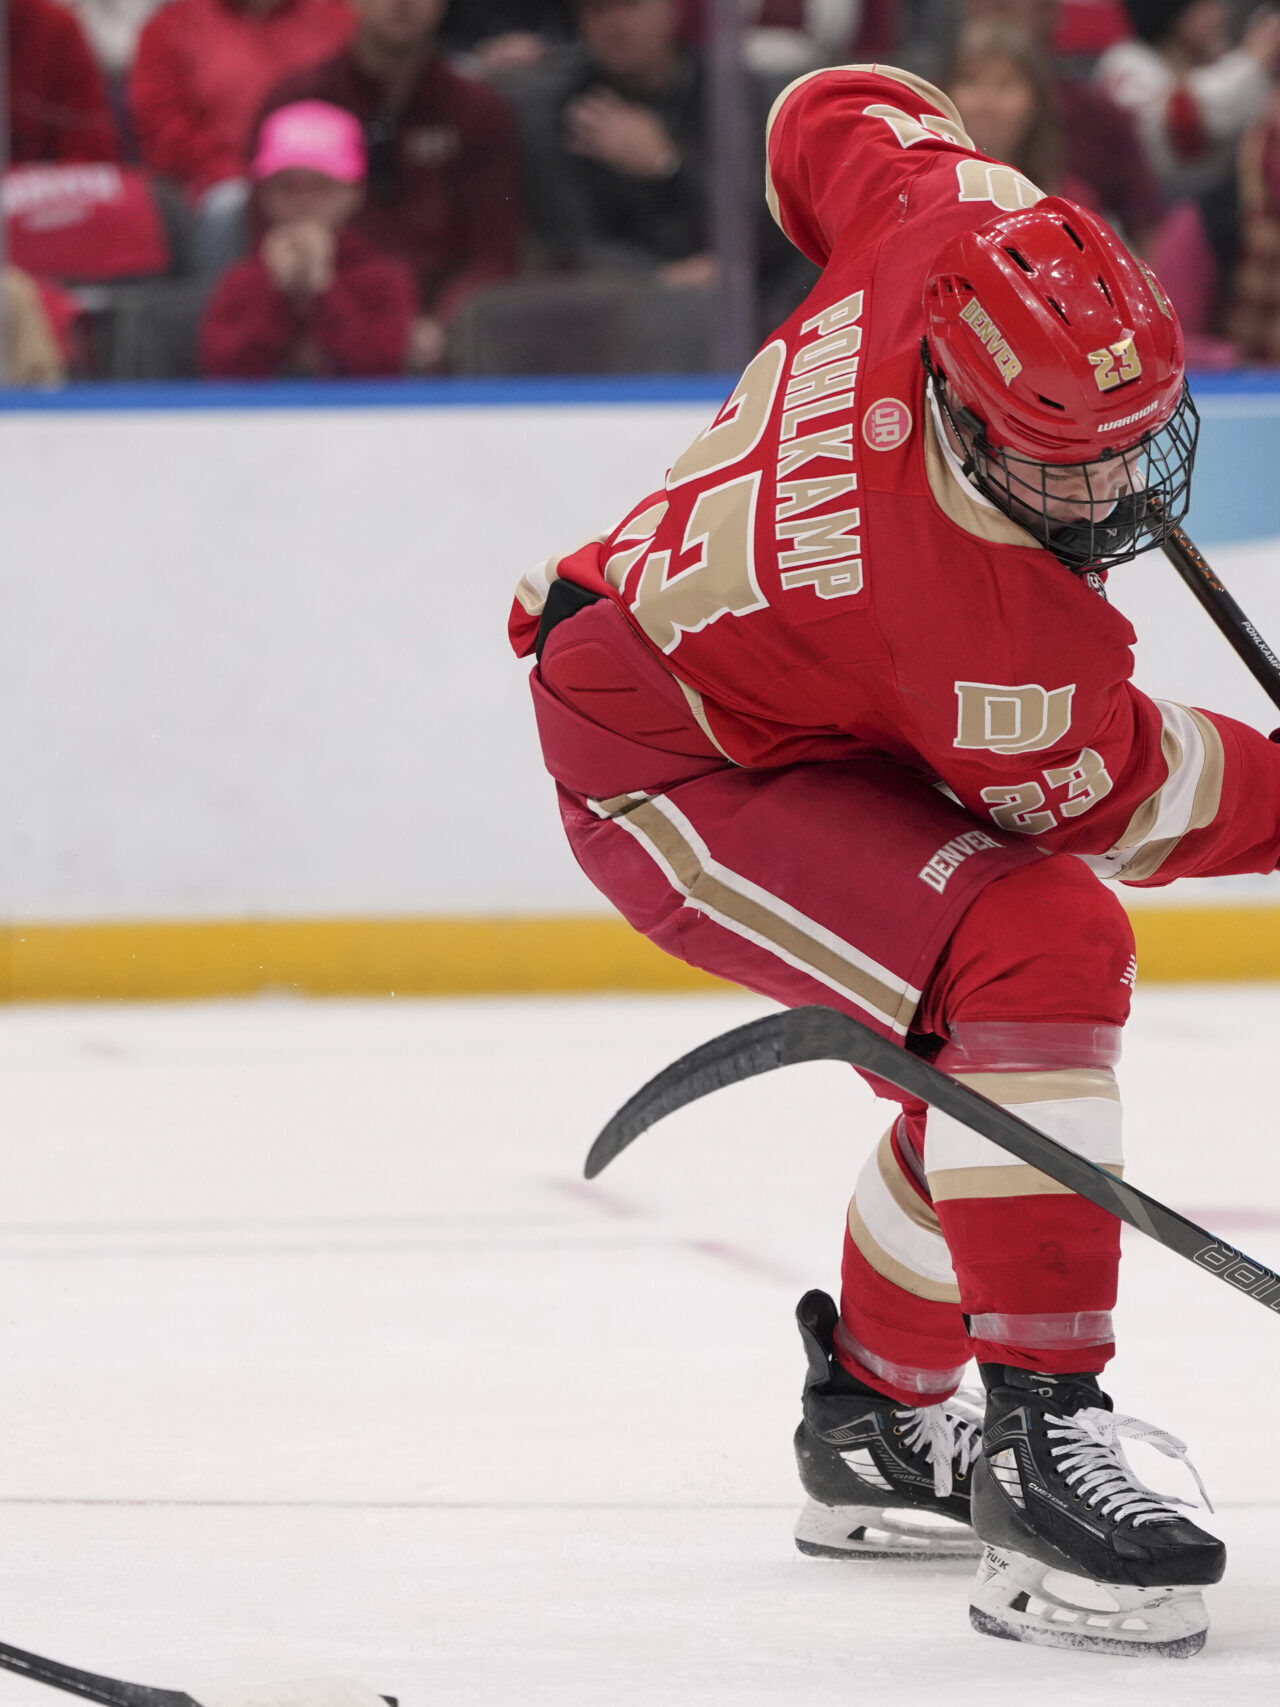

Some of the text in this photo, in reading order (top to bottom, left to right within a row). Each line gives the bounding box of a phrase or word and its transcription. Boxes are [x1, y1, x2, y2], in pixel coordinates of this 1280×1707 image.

[959, 297, 1023, 388] DENVER
[1087, 337, 1142, 392] 23
[774, 290, 865, 601] POHLKAMP
[874, 407, 900, 444] DR
[1097, 400, 1159, 432] WARRIOR
[980, 747, 1114, 835] 23
[917, 831, 1006, 895] DENVER
